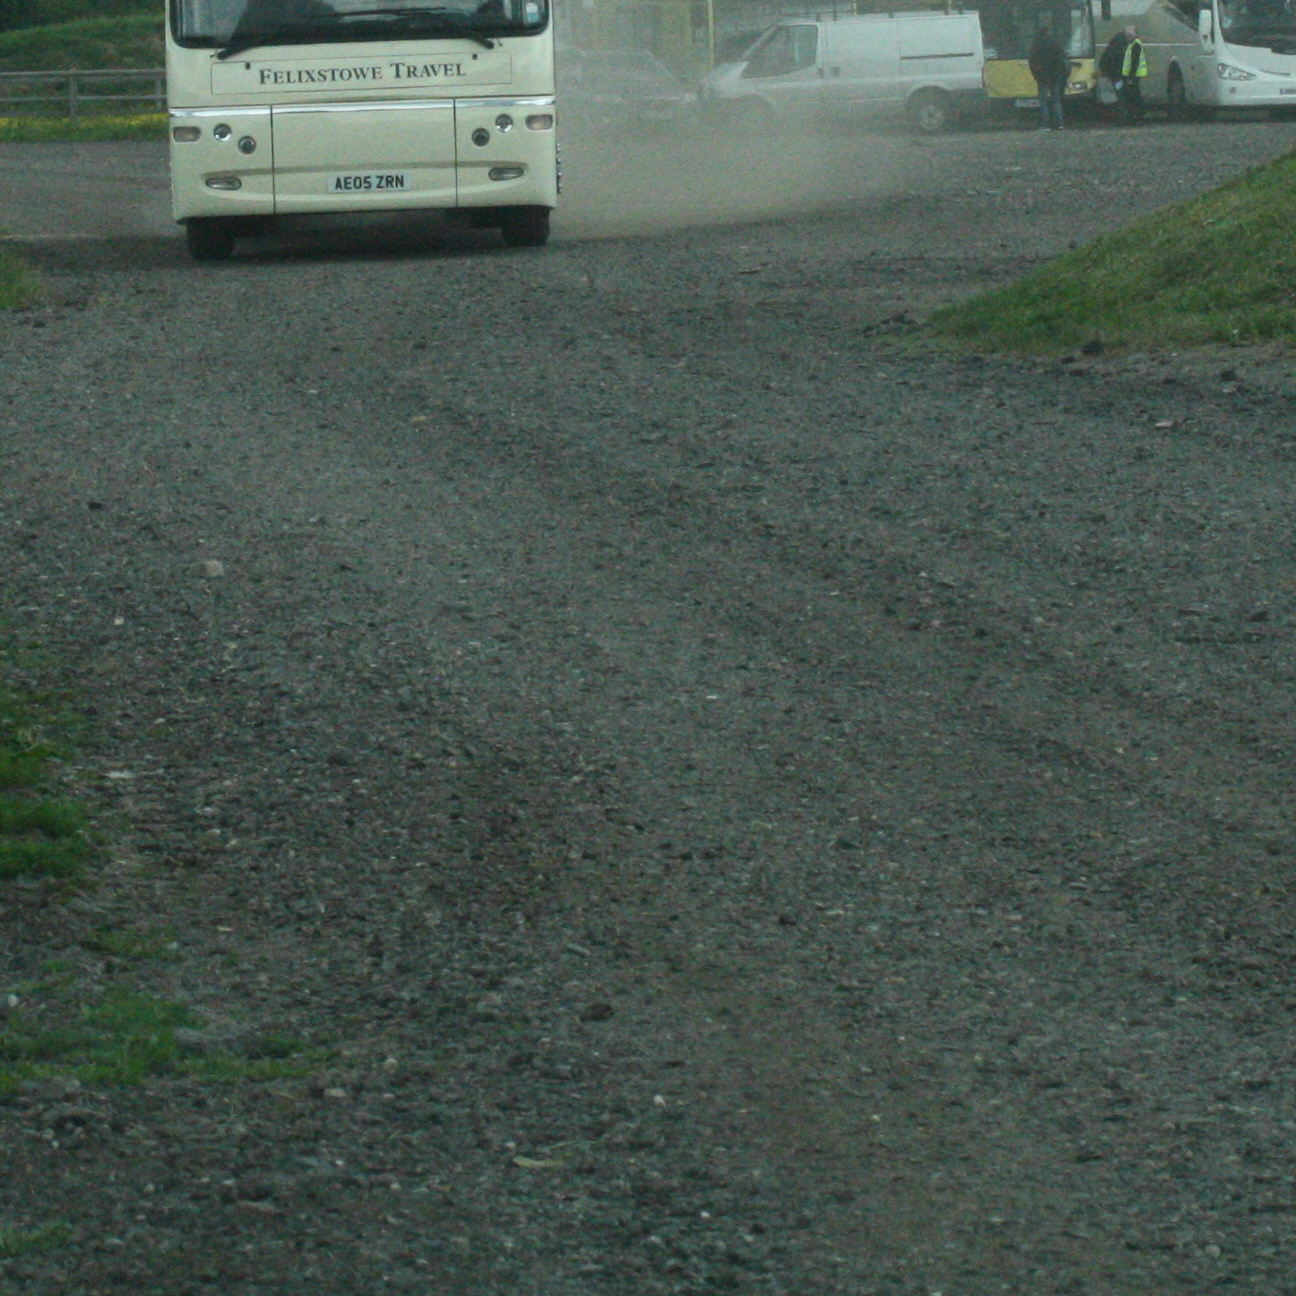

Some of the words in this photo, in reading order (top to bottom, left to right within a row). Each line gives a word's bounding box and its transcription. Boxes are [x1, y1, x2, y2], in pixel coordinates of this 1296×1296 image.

[259, 66, 382, 85] FELIXSTOWE
[390, 62, 466, 80] TRAVEL
[335, 175, 371, 190] AE05
[376, 174, 404, 189] ZRN
